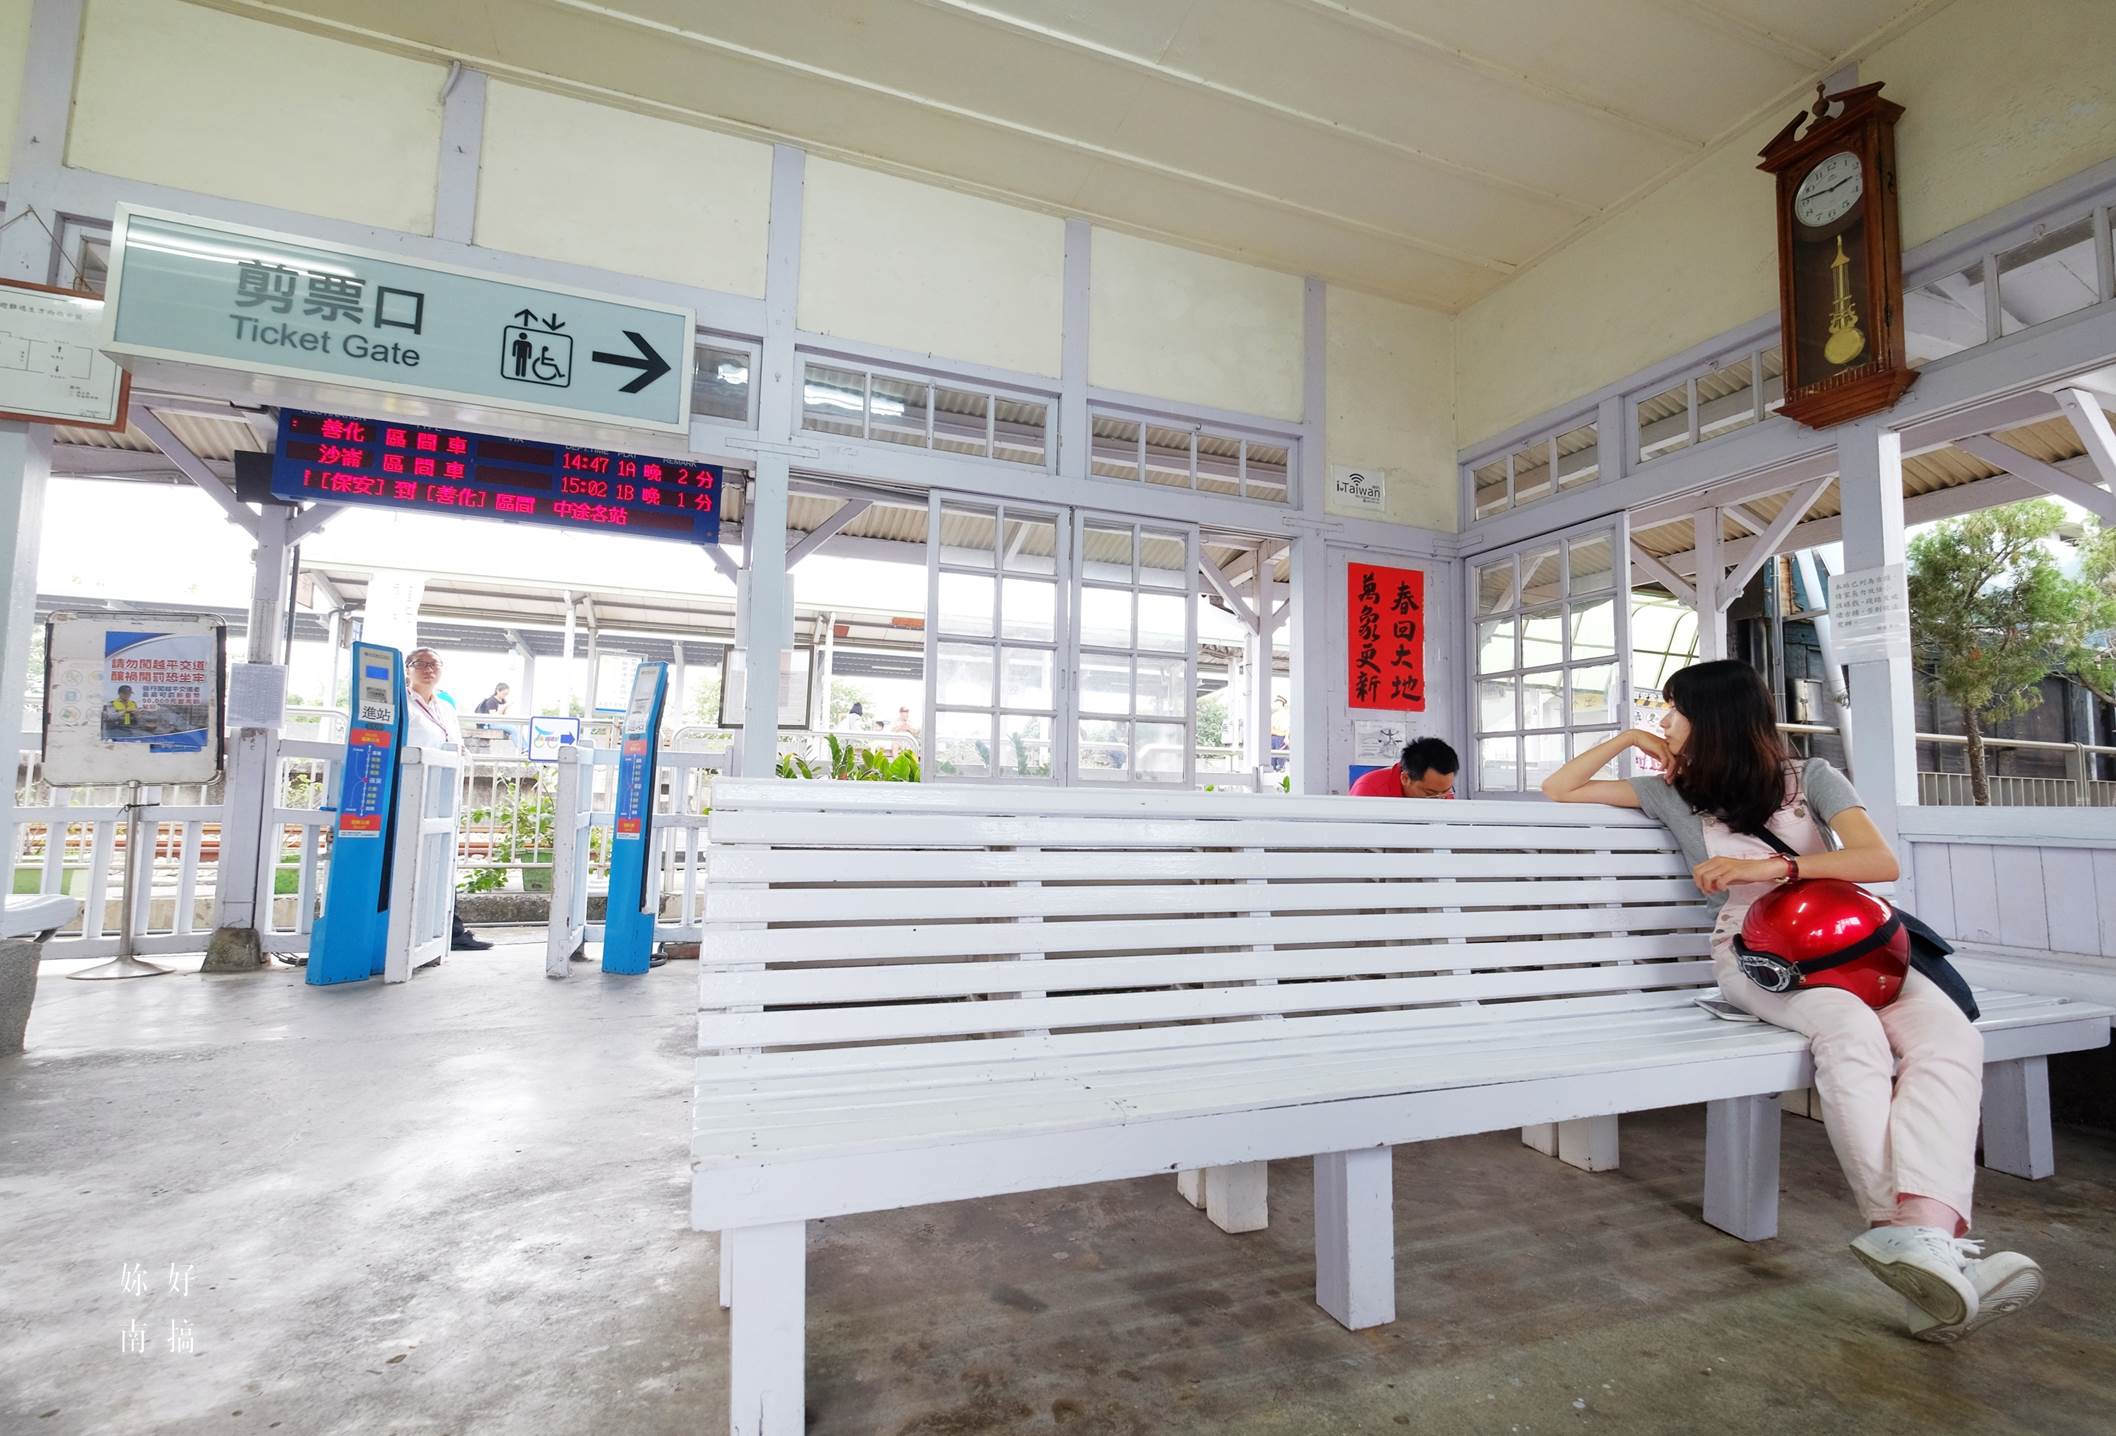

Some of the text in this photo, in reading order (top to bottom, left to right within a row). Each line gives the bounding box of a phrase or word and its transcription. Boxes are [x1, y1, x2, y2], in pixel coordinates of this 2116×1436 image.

[234, 259, 425, 336] 剪票口
[229, 313, 421, 367] Ticket Gate
[318, 444, 364, 468] 沙崙
[560, 476, 609, 499] 15:02
[616, 483, 635, 501] 1B
[695, 493, 713, 512] 分
[321, 418, 366, 443] 善化
[562, 452, 610, 475] 14:47
[617, 460, 636, 478] 1A
[677, 468, 688, 485] 2
[696, 470, 714, 489] 分
[1355, 570, 1382, 704] 萬象更新
[1390, 580, 1422, 703] 春回大地
[361, 705, 392, 722] 進站
